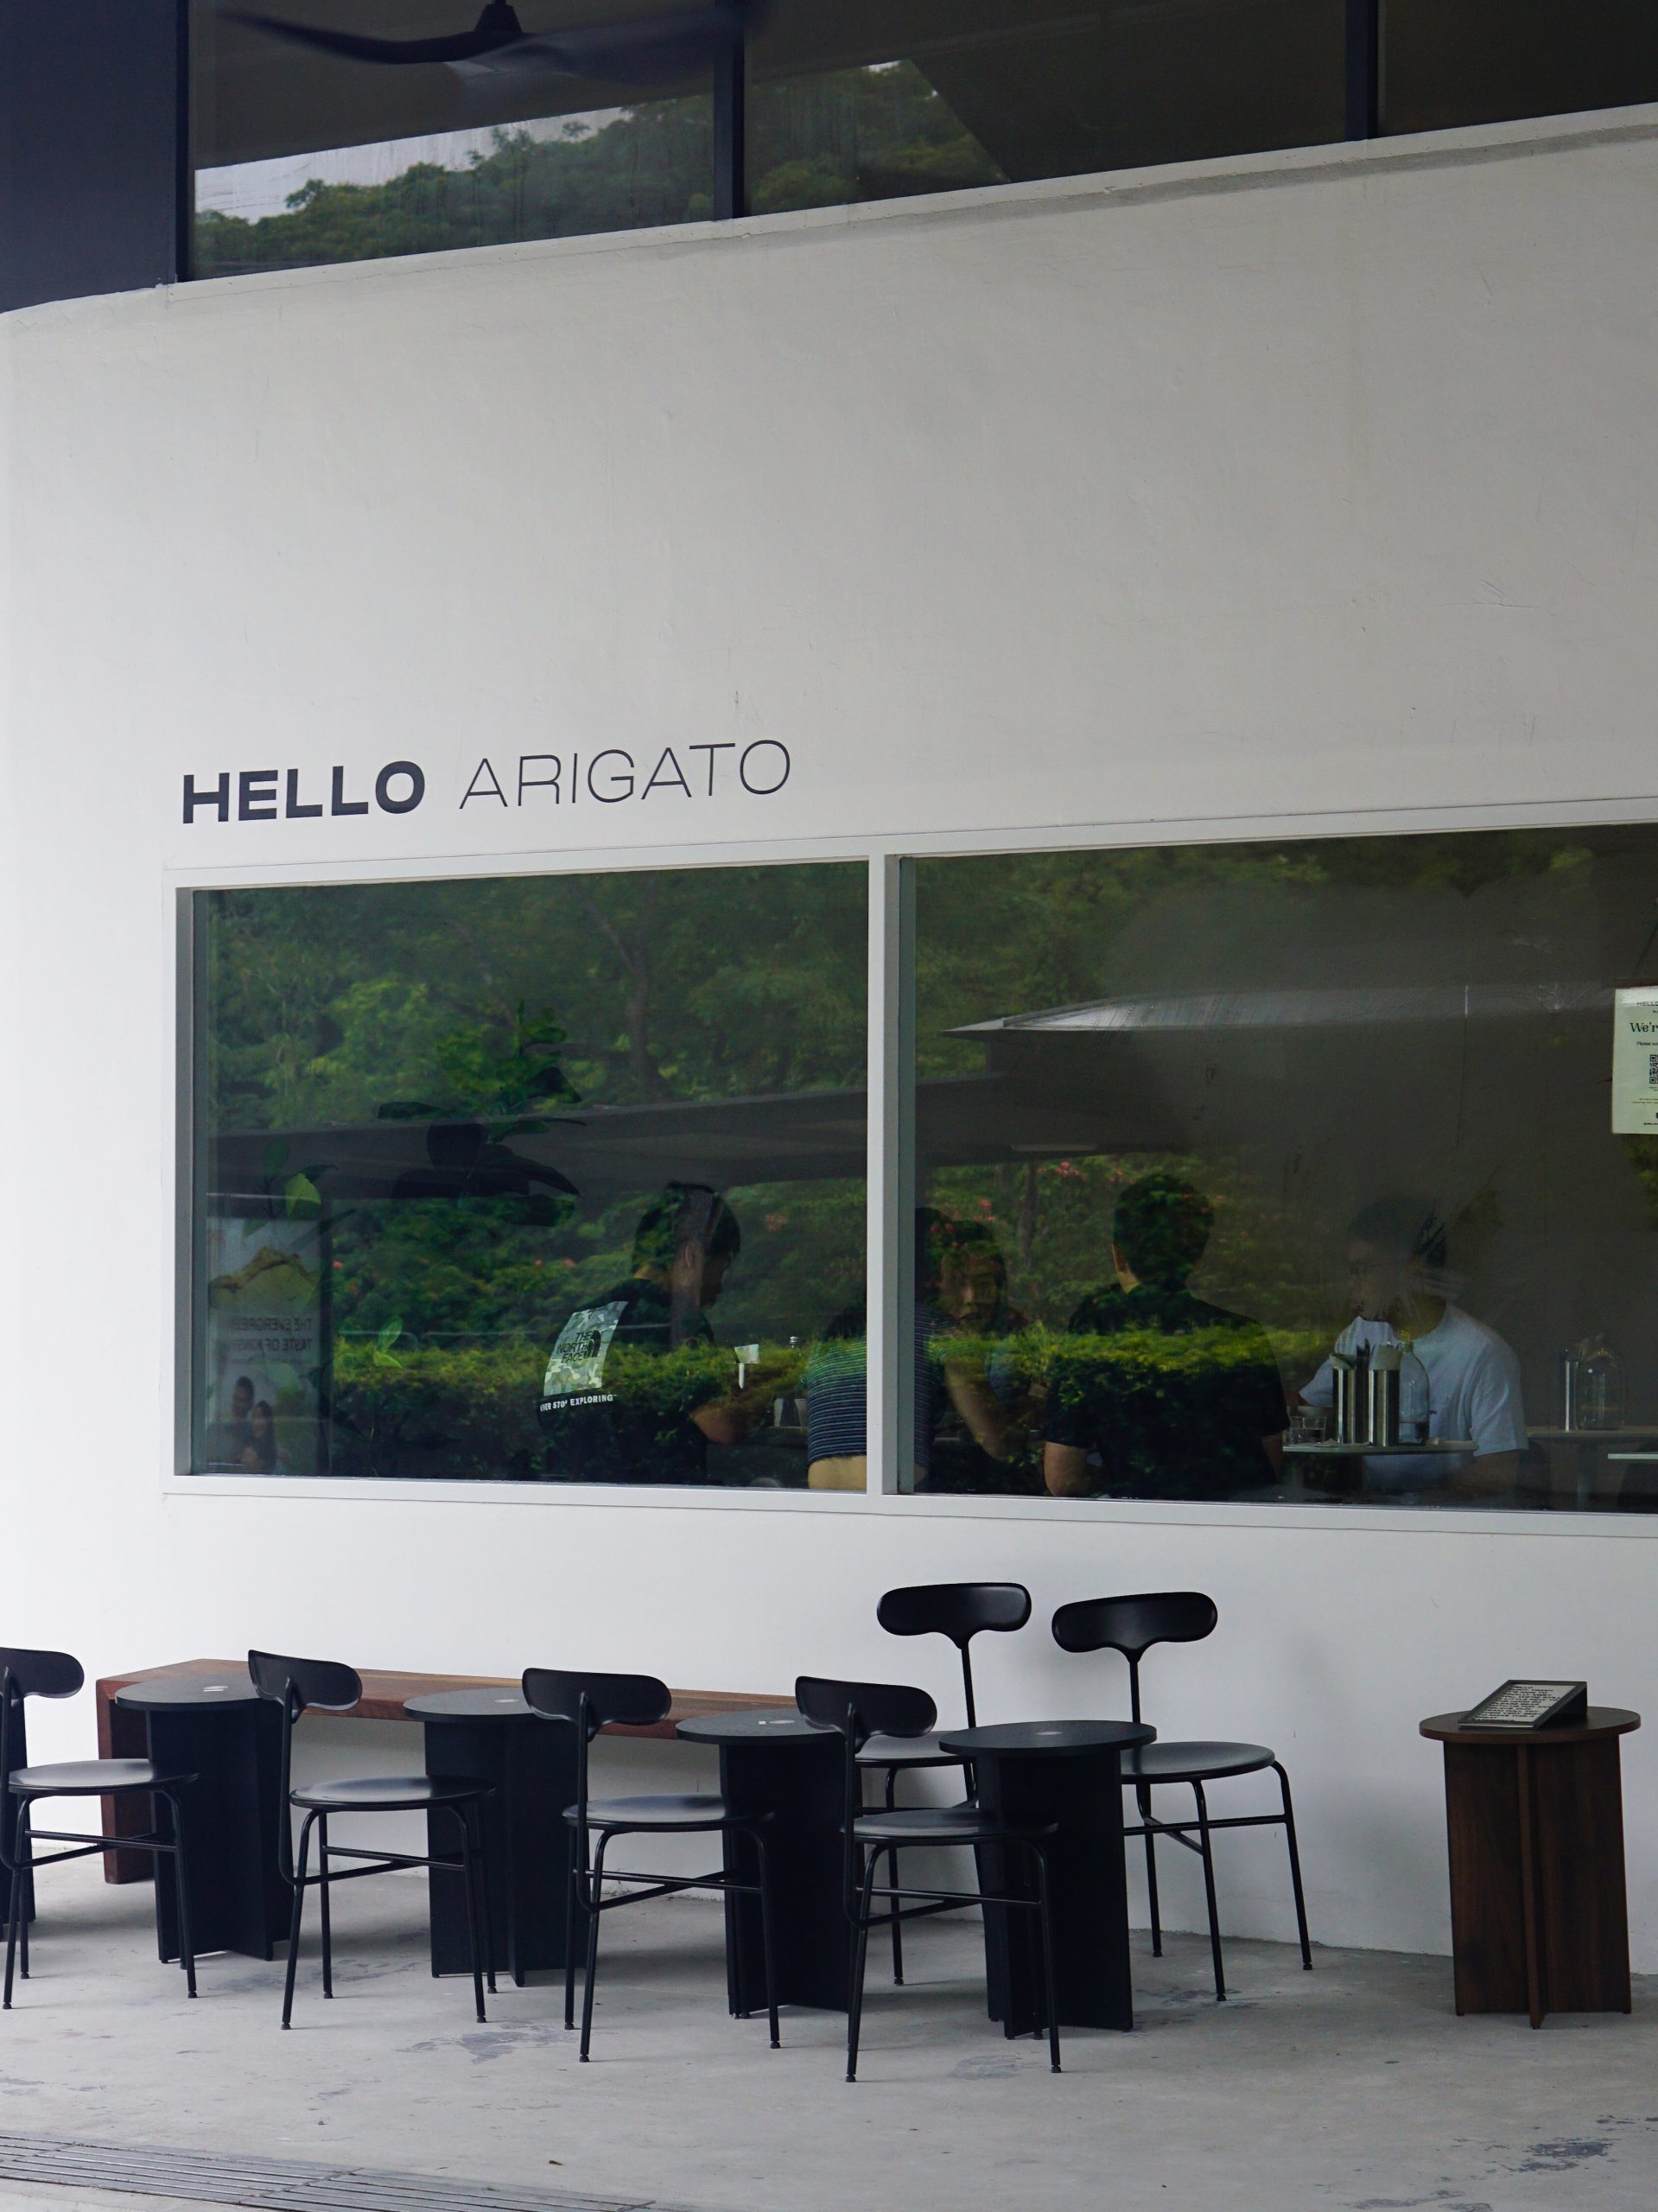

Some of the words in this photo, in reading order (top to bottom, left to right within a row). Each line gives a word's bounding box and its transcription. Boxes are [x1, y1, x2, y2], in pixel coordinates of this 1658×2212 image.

[182, 760, 425, 823] HELLO
[460, 739, 791, 810] ARIGATO
[576, 1331, 594, 1341] THE
[557, 1341, 588, 1353] NORTH
[561, 1351, 583, 1363] FACE
[570, 1395, 613, 1406] EXPLORING
